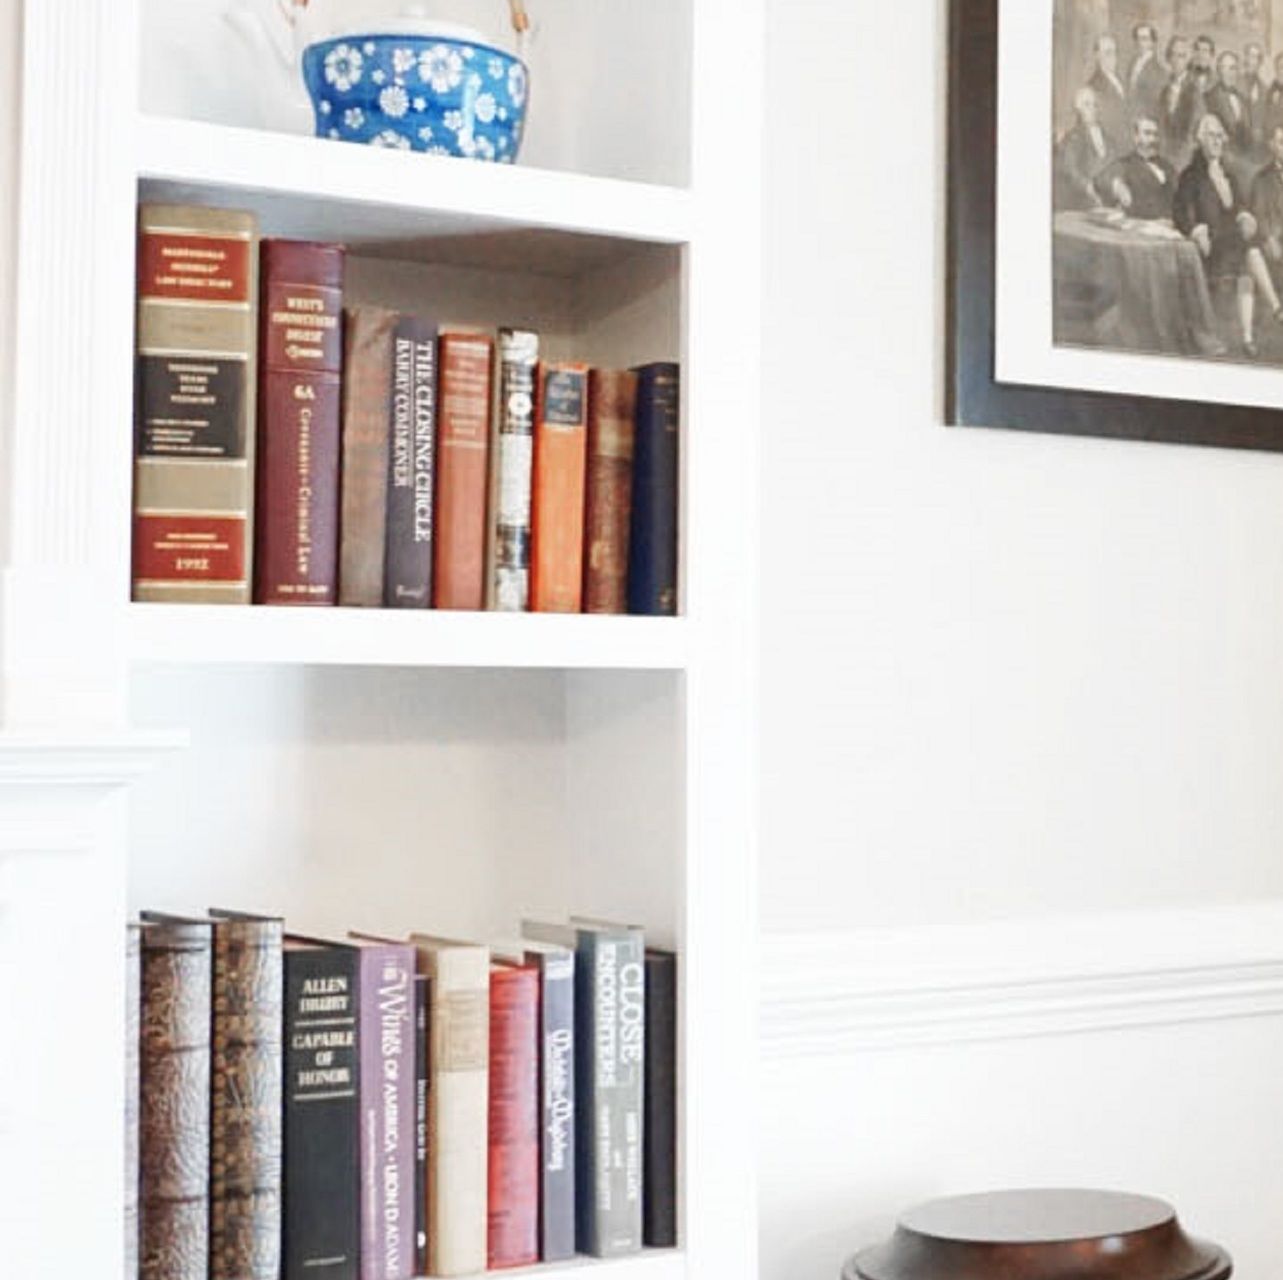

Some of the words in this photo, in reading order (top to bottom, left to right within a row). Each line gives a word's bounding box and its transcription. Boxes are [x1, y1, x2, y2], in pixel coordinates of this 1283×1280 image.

[416, 340, 433, 383] THE
[415, 384, 433, 470] CLOSING
[414, 472, 432, 542] CIRCLE
[303, 977, 347, 994] ALLEN
[599, 942, 617, 1087] ENCOUNTERS
[620, 962, 643, 1064] CLOSE
[292, 1031, 354, 1050] CAPABLE
[315, 1051, 333, 1066] OF
[298, 1068, 350, 1086] HONOR
[383, 1059, 398, 1081] OF
[383, 1083, 399, 1153] AMERICA
